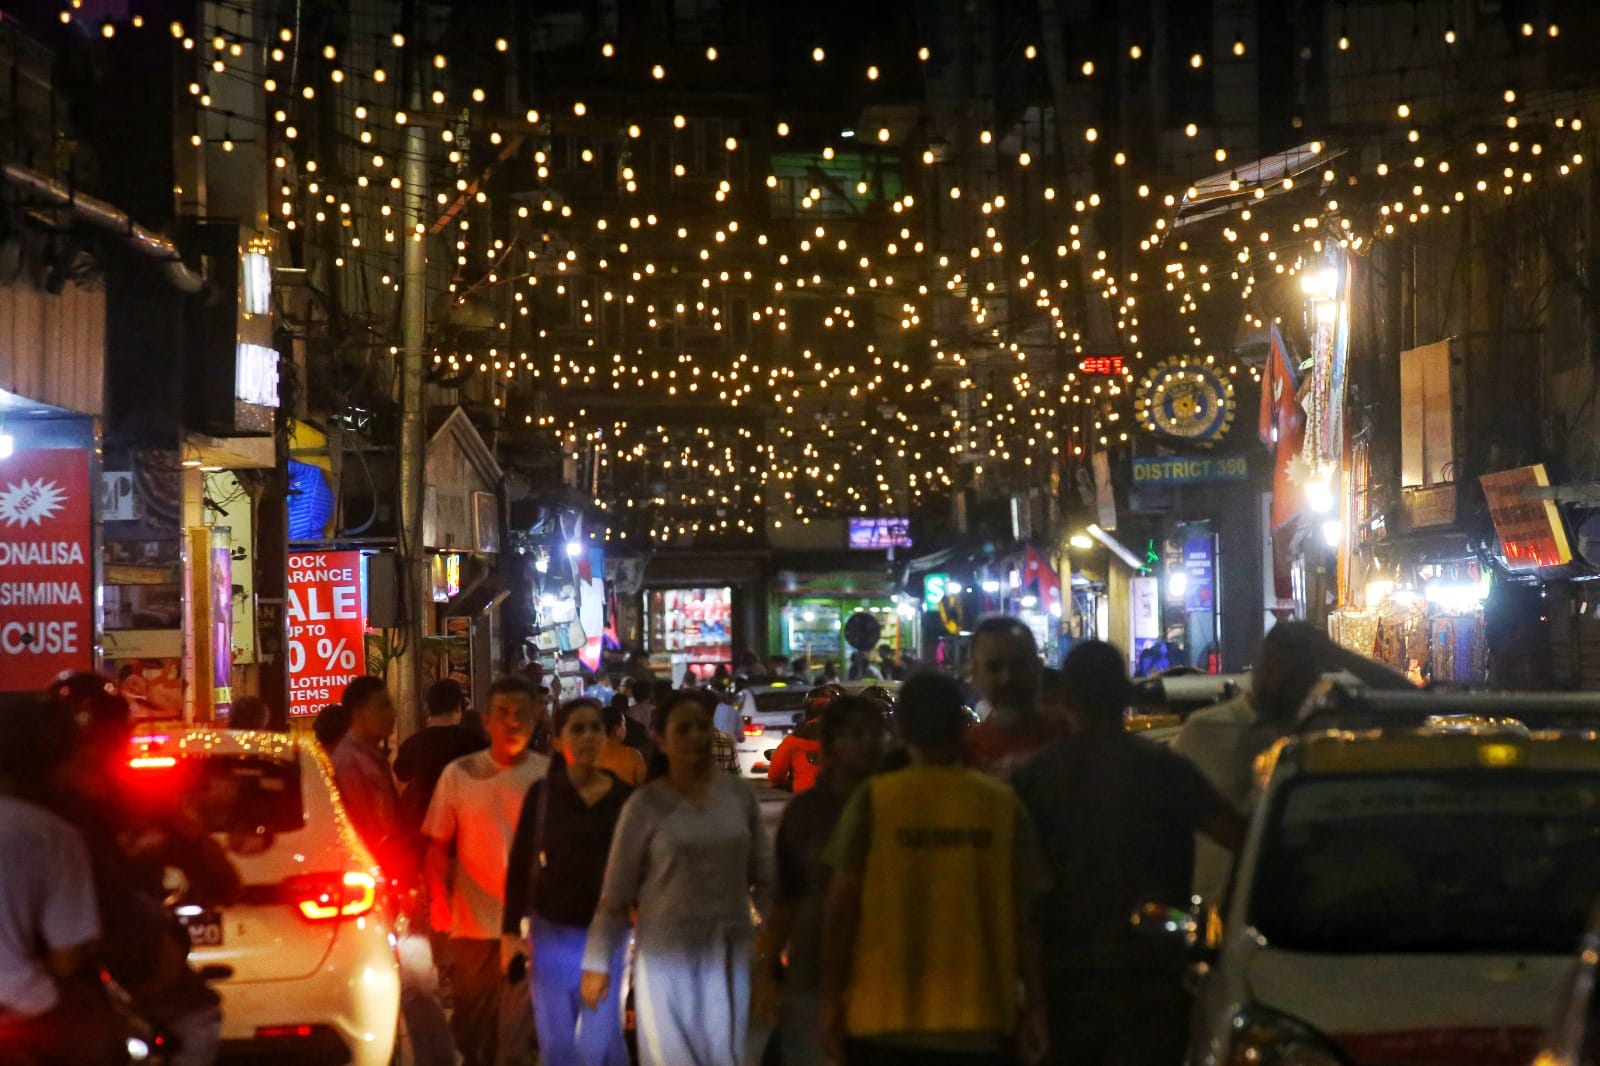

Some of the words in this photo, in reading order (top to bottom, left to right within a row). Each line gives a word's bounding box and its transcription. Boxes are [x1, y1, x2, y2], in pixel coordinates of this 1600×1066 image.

[1134, 460, 1210, 480] DISTRICT
[13, 486, 43, 515] NEW
[0, 541, 84, 565] ONALISA
[288, 554, 327, 569] OCK
[0, 582, 83, 605] SHMINA
[2, 621, 78, 655] OUSE
[306, 624, 326, 637] TO
[289, 688, 330, 701] TEMS
[289, 704, 308, 714] OR
